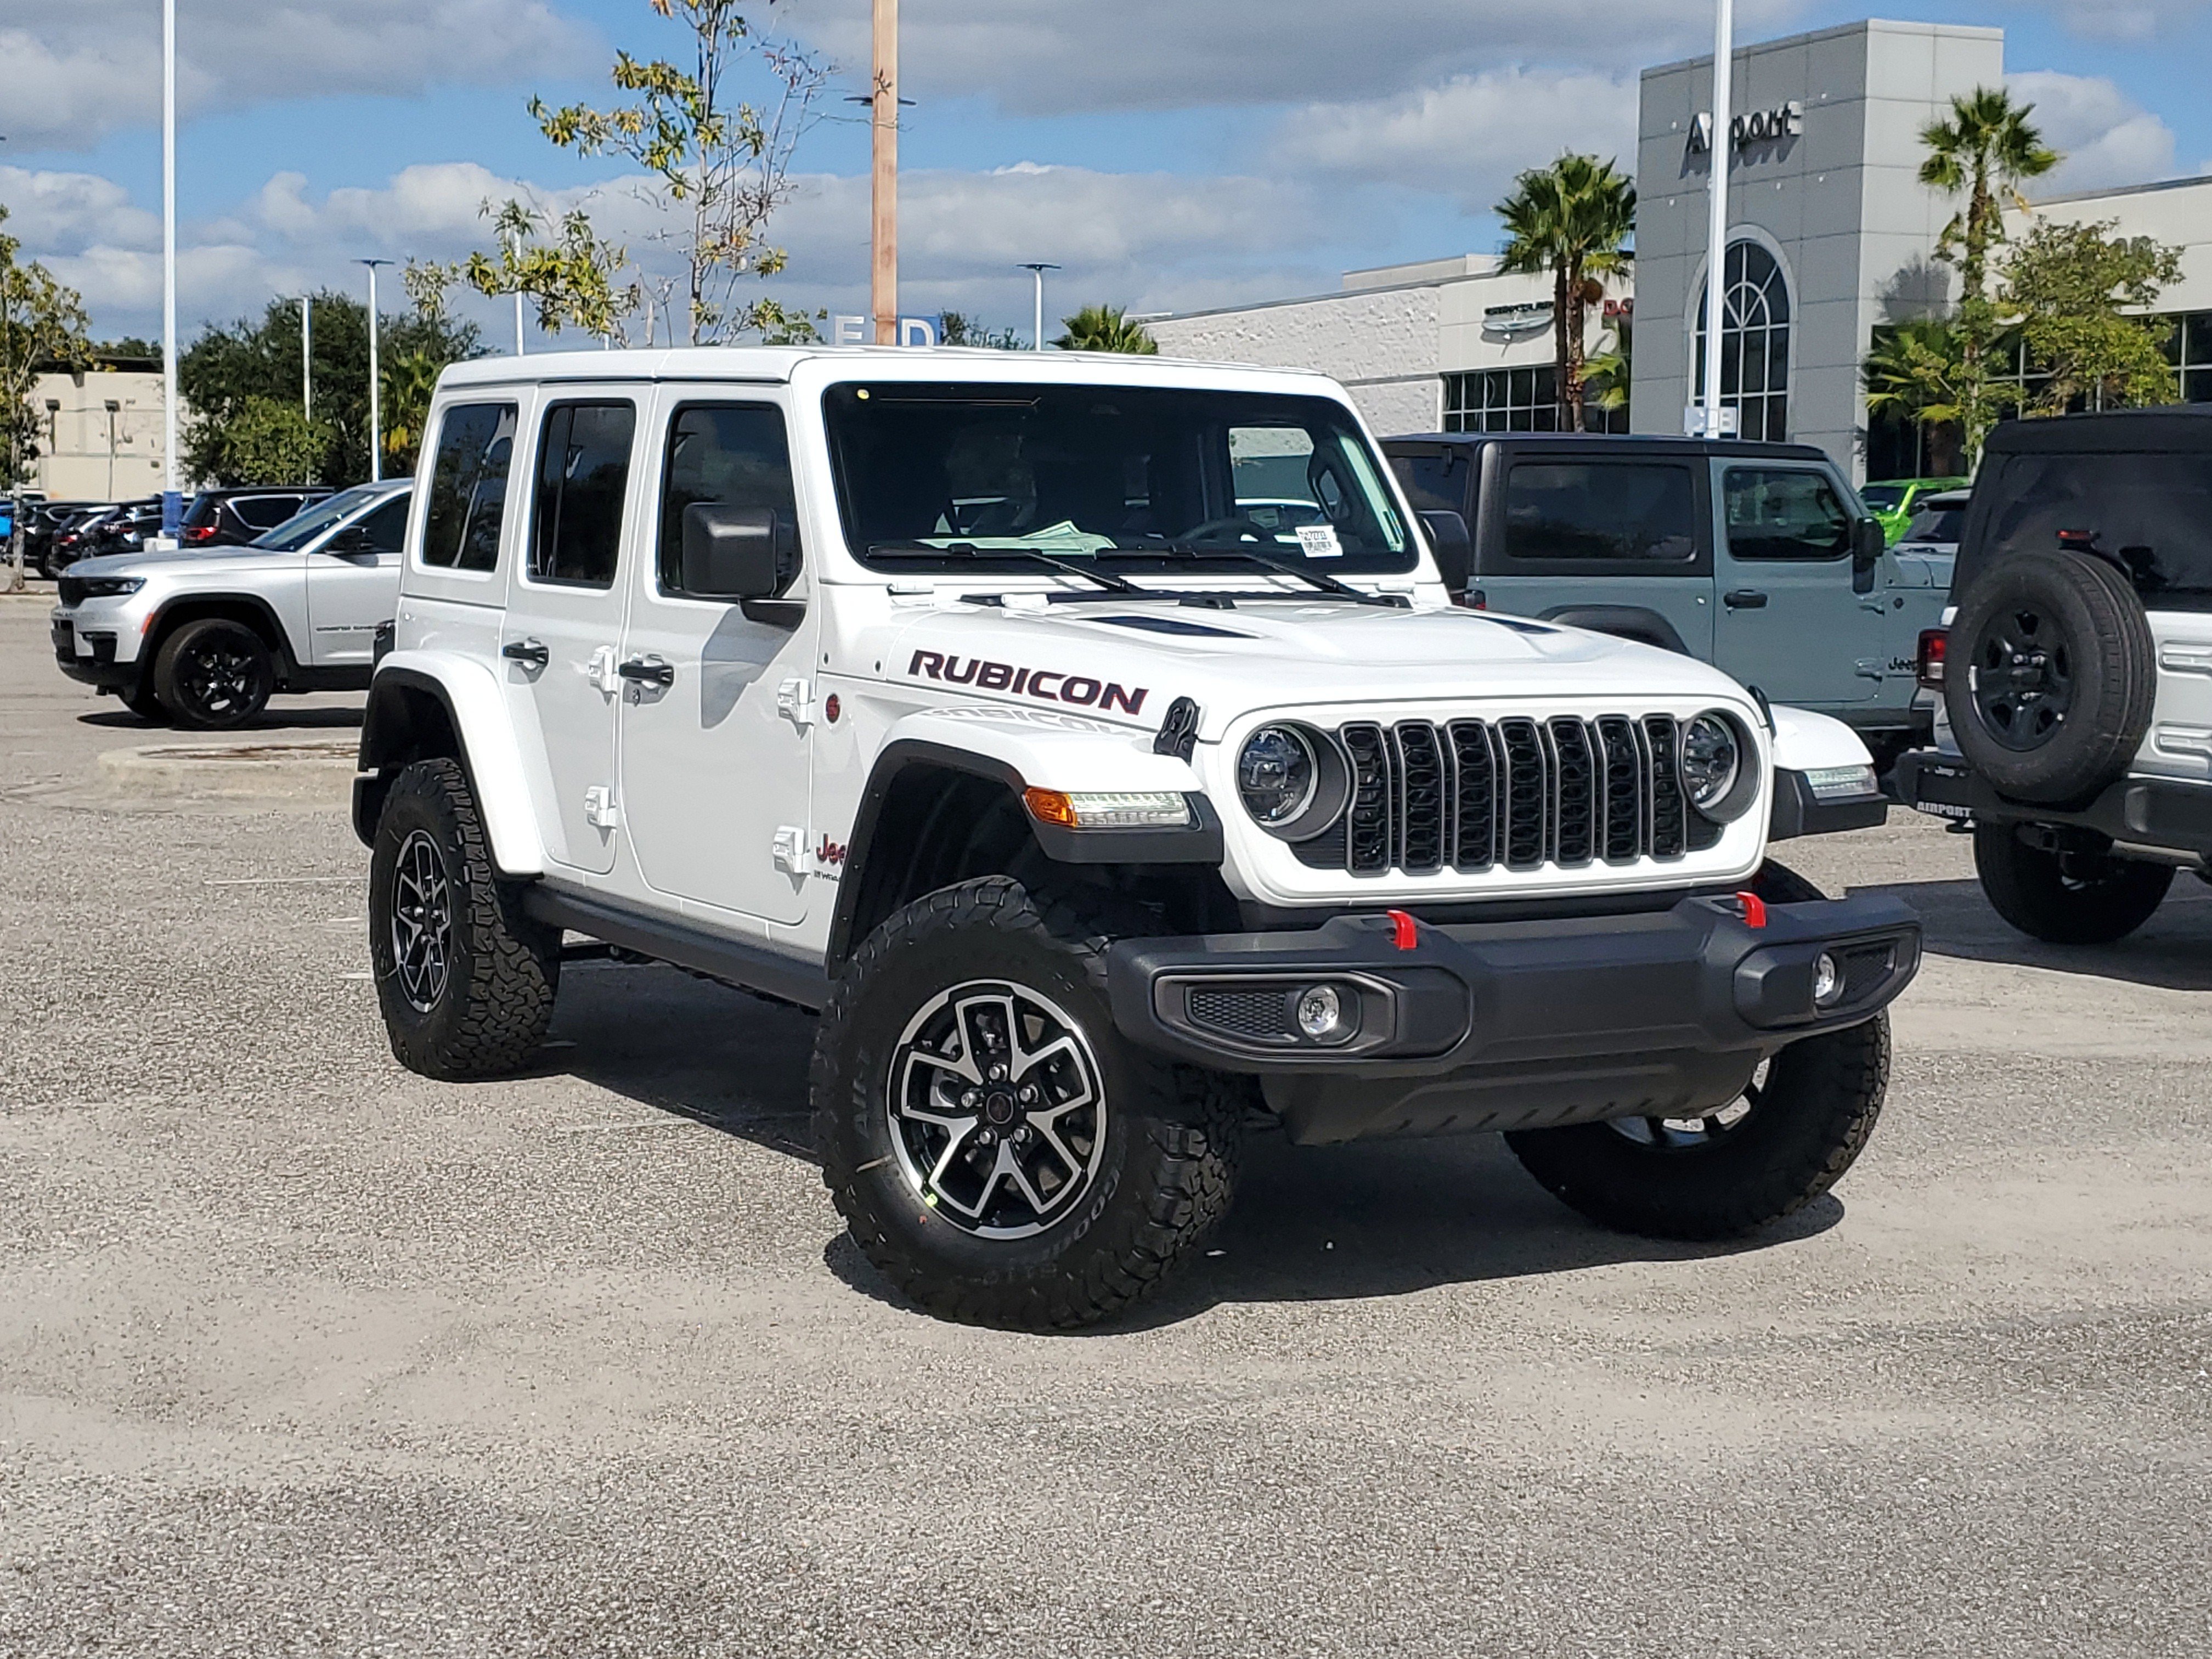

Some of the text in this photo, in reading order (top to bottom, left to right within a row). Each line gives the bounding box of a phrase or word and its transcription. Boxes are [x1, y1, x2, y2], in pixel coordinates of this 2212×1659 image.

[1685, 101, 1802, 153] Aport
[908, 649, 1149, 715] RUBICON
[1917, 801, 1975, 818] AIRPORT
[816, 833, 847, 866] Jee
